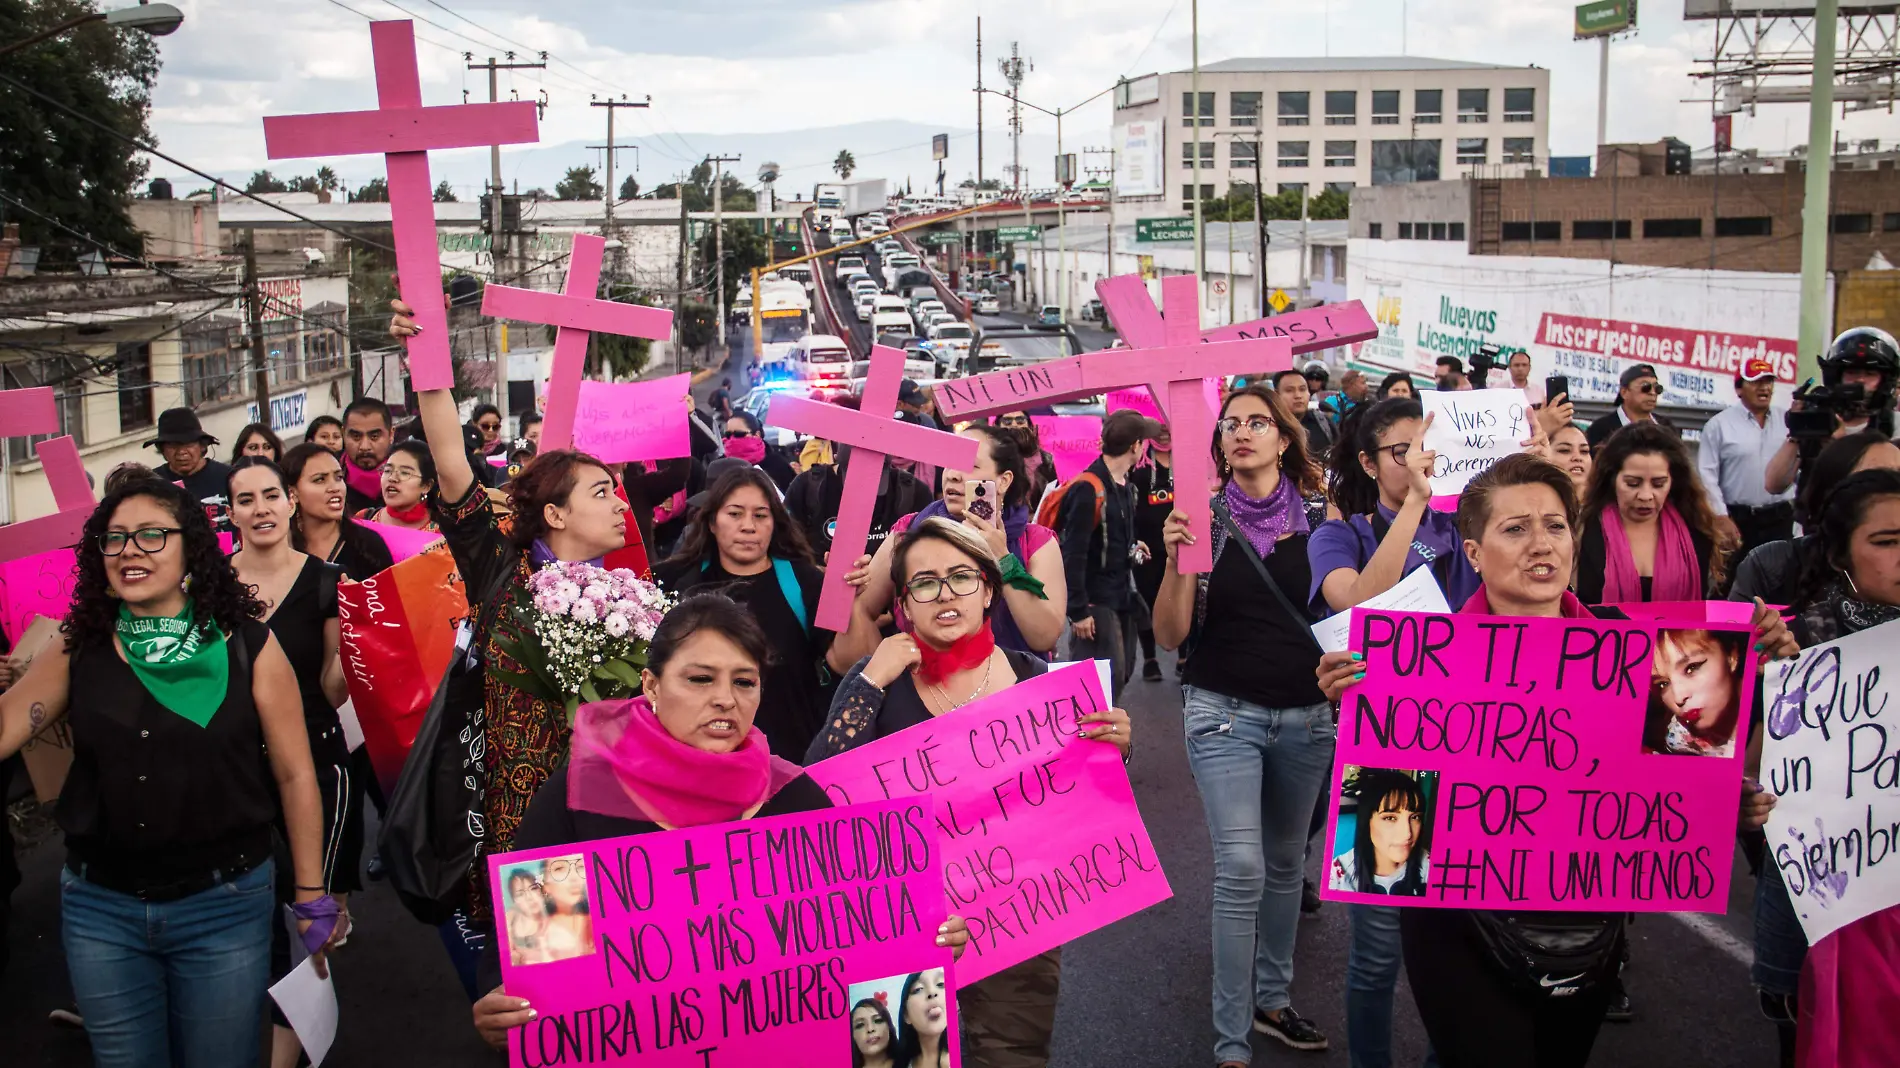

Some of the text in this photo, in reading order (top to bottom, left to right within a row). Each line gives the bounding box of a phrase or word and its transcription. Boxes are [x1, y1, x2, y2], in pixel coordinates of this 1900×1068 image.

[1440, 294, 1498, 334] Nuevas
[1545, 314, 1685, 364] Inscripciones
[1007, 367, 1054, 397] UN
[1441, 400, 1497, 432] VIVAS
[159, 618, 189, 635] SEGURO
[1362, 615, 1652, 699] POR TI, POR
[969, 677, 1098, 769] CRIMEN
[1354, 693, 1600, 778] NOSOTRAS,
[1771, 756, 1812, 797] un
[1447, 782, 1689, 843] POR TODAS
[592, 845, 654, 918] NO
[725, 805, 930, 901] FEMINICIDIOS
[1549, 850, 1602, 902] UNA
[1612, 846, 1715, 901] MENOS
[964, 832, 1158, 957] PATRIARCAL
[602, 882, 922, 988] NO MÁS VIOLENCIA
[519, 956, 850, 1068] CONTRA LAS MUJERES
